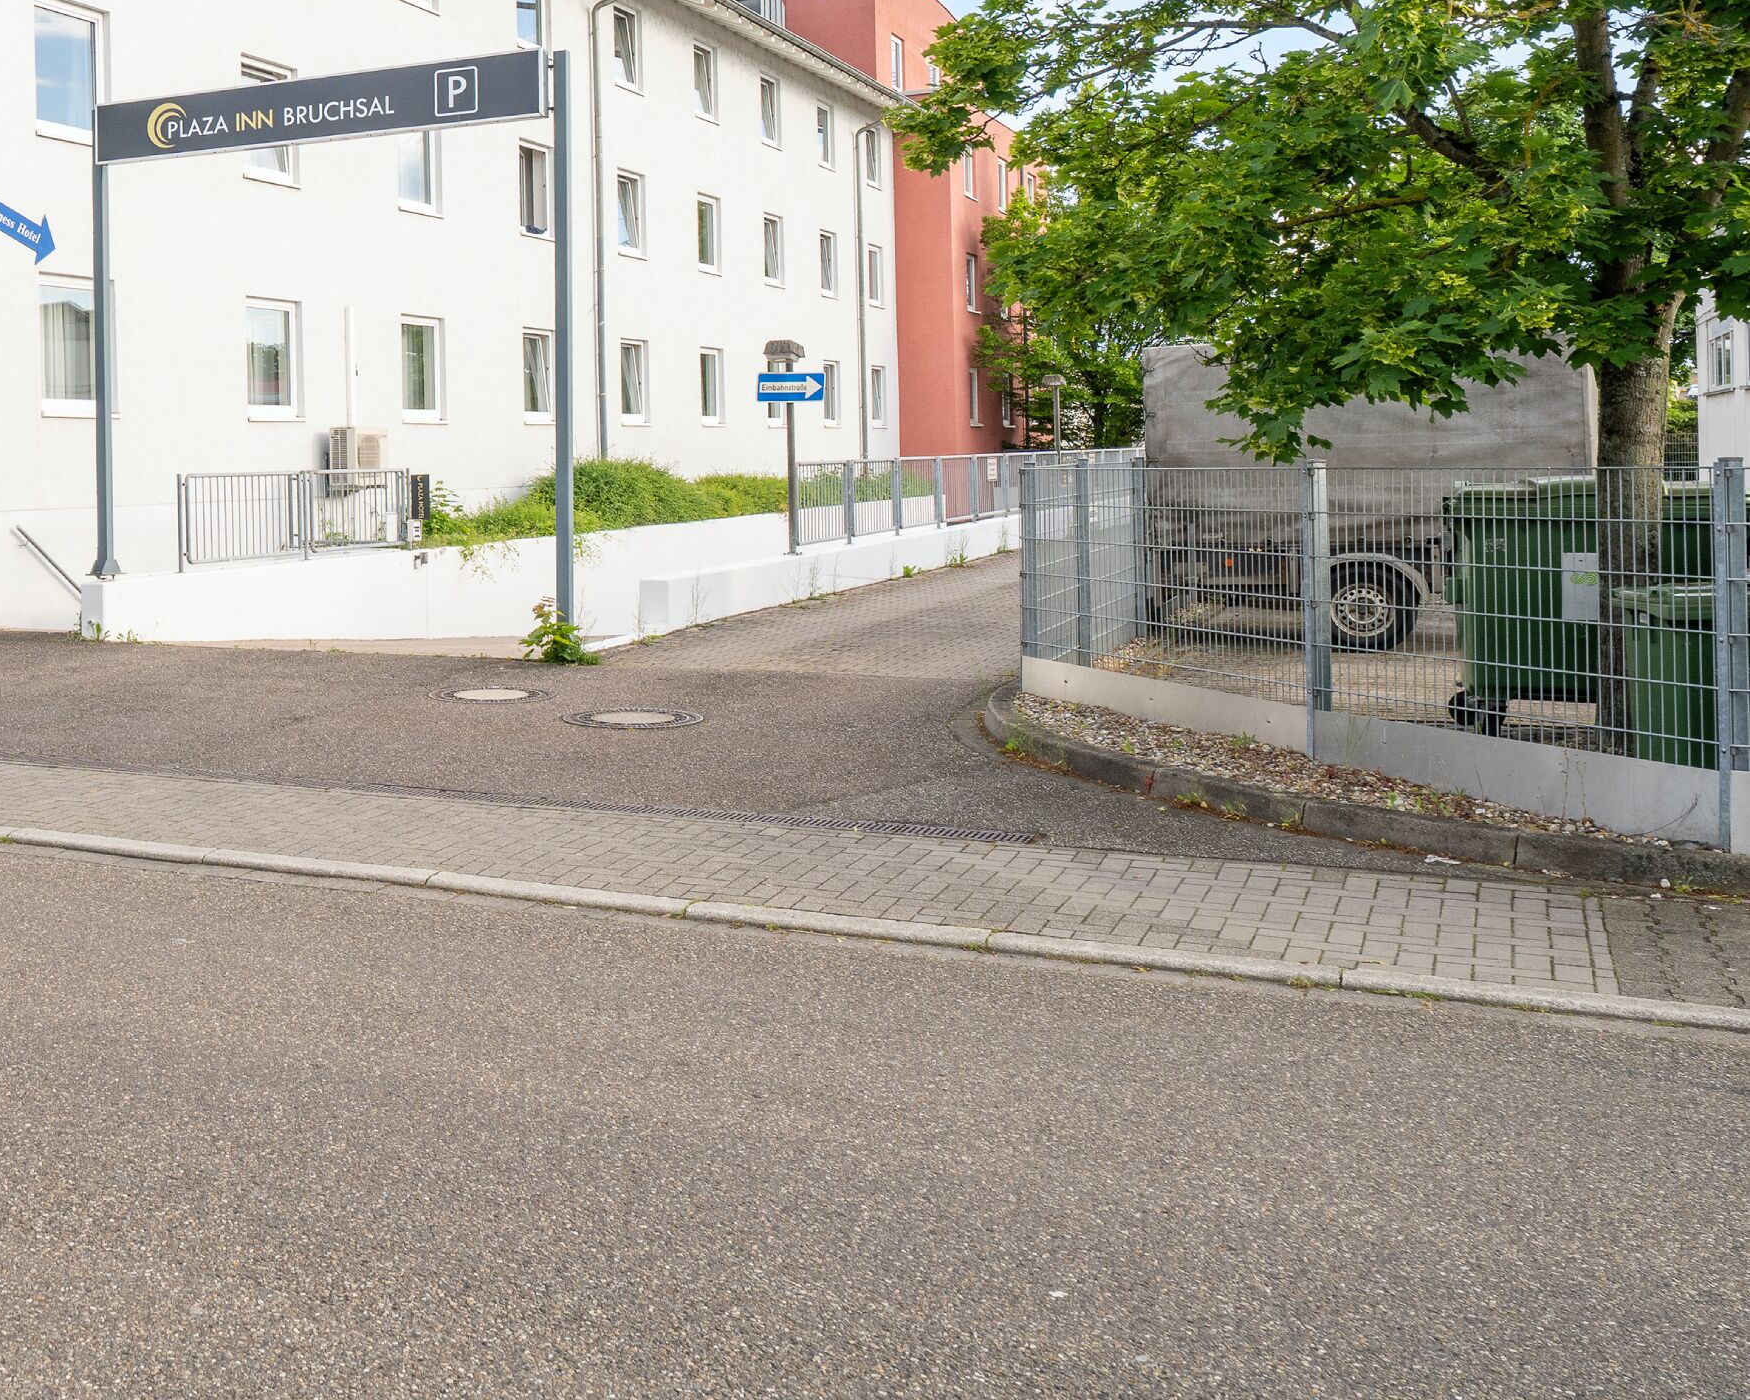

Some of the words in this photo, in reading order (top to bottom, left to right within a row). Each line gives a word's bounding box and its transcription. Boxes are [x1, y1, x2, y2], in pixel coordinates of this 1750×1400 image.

[448, 75, 468, 108] P
[167, 115, 229, 139] PLAZA
[235, 109, 274, 132] INN
[283, 95, 395, 127] BRUCHSAL
[16, 222, 42, 244] Hotel
[761, 383, 808, 391] Einbahnstraße
